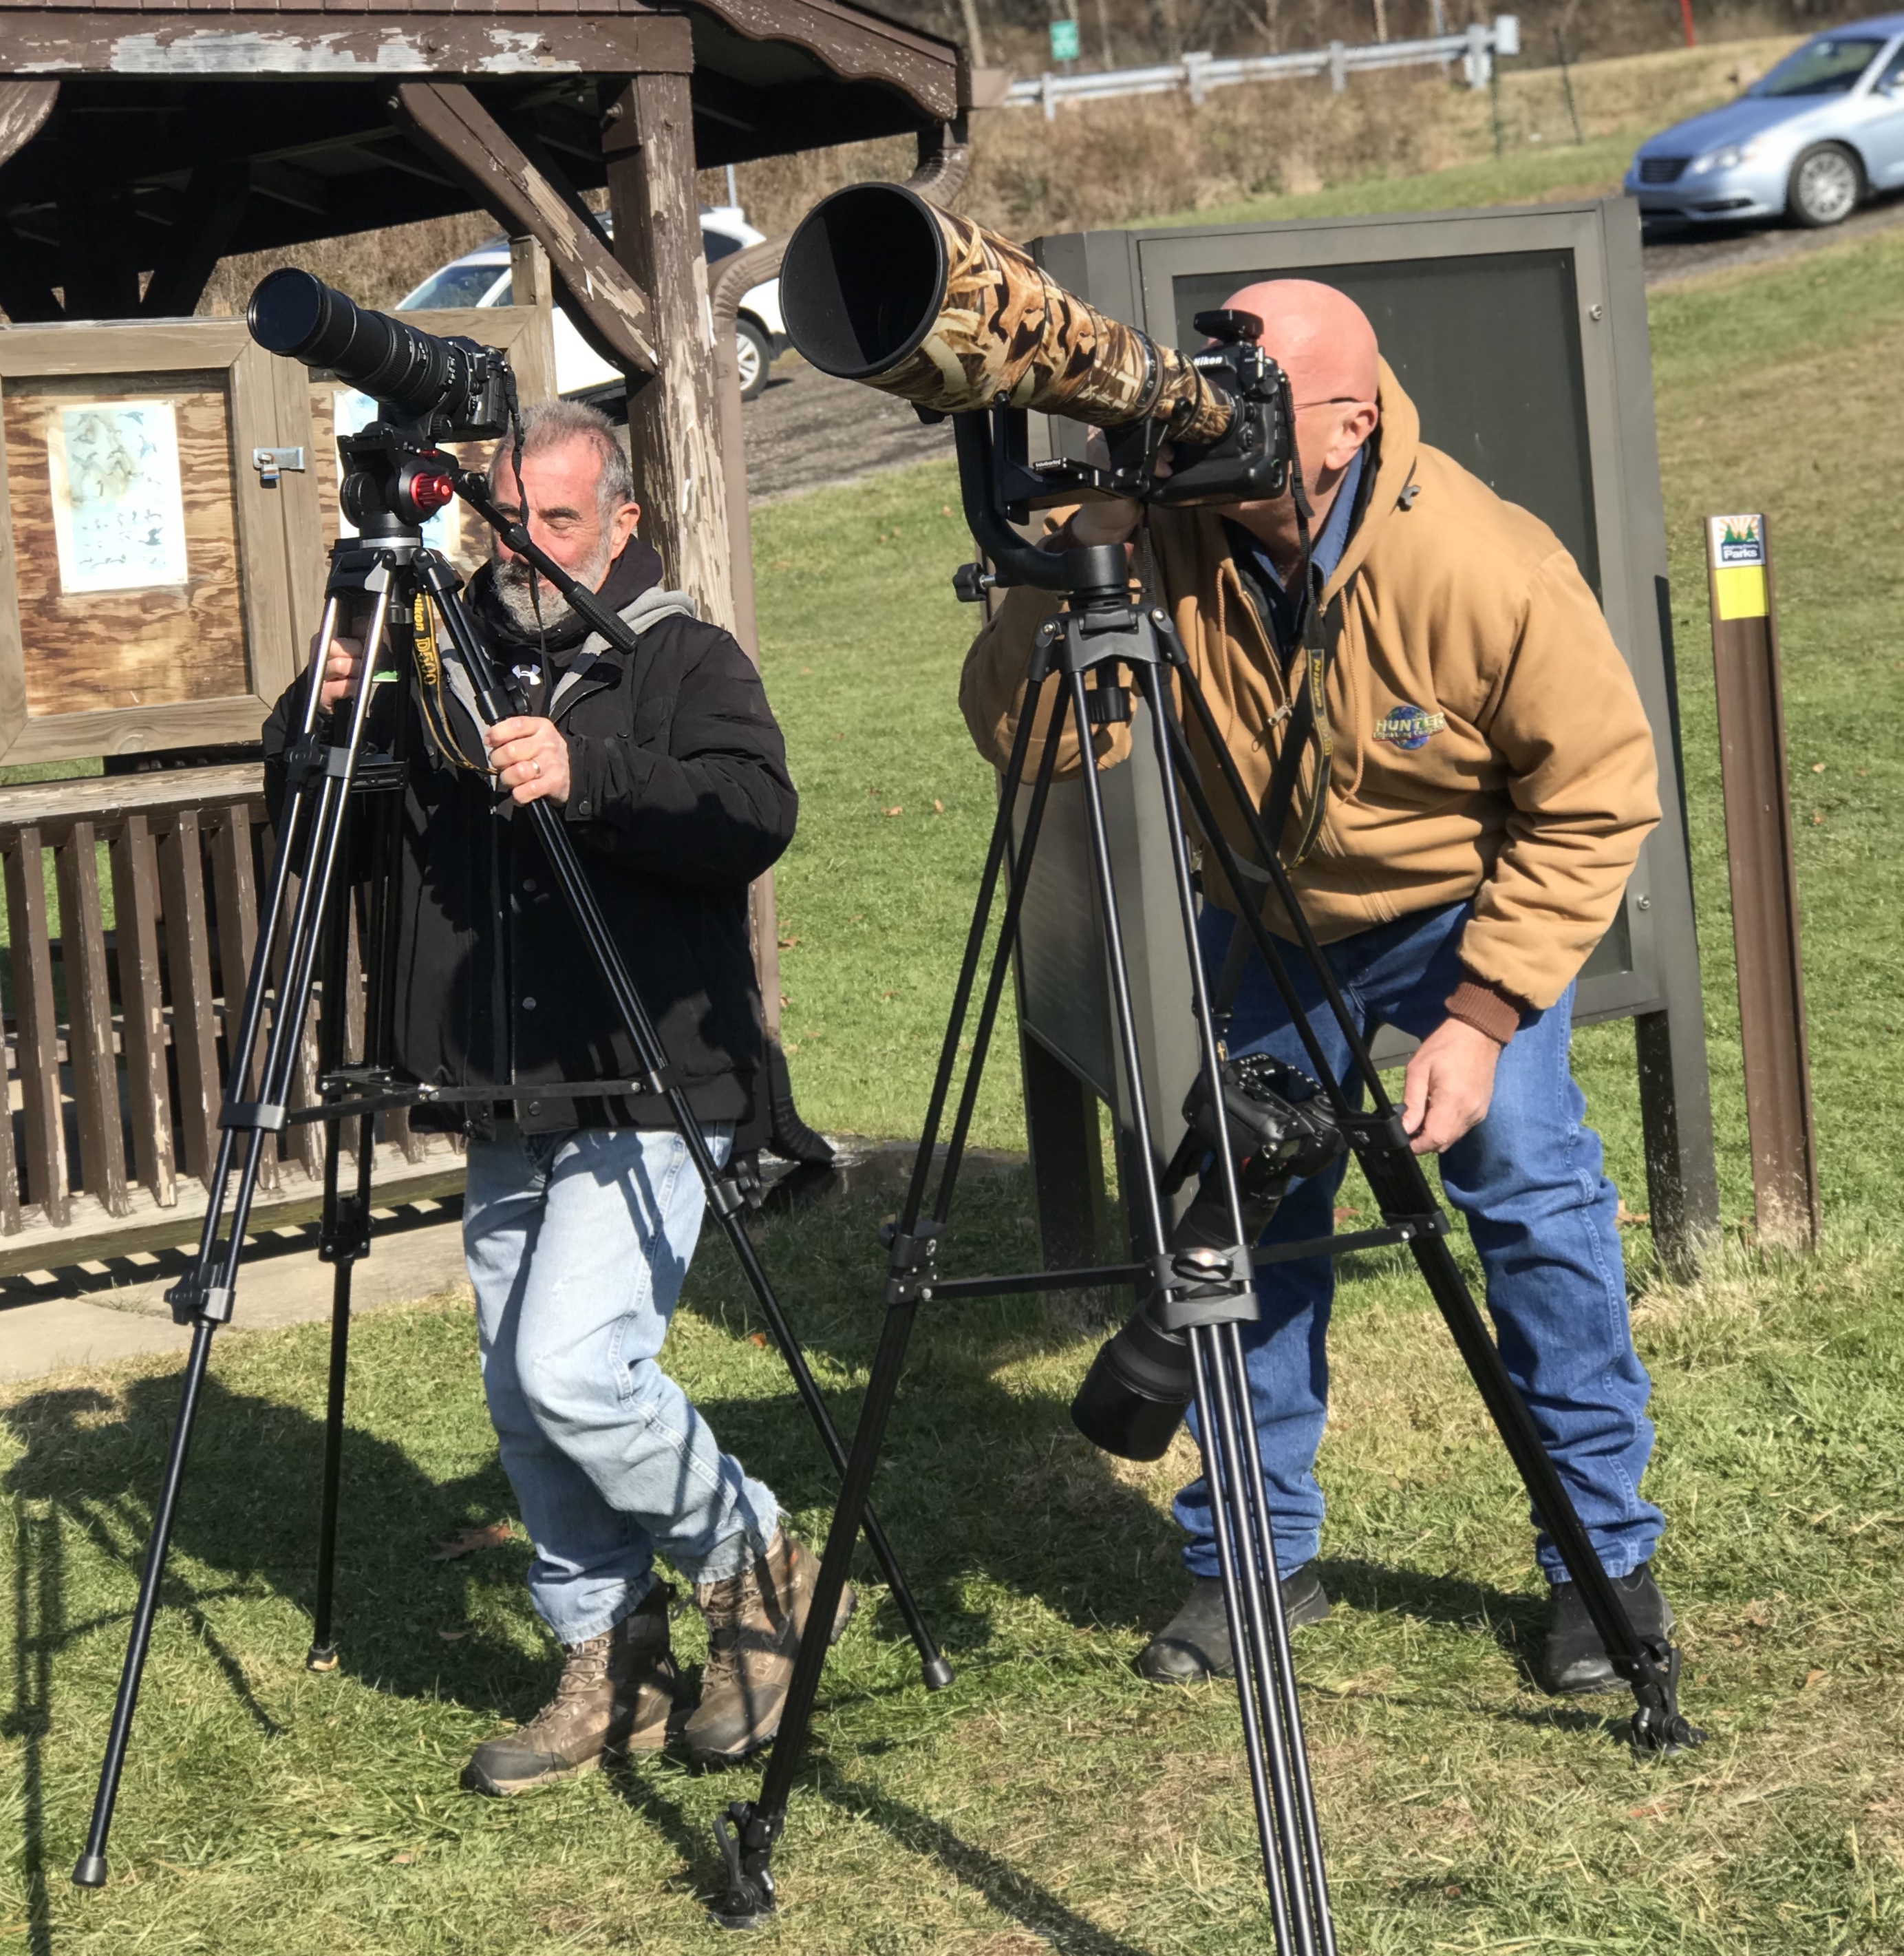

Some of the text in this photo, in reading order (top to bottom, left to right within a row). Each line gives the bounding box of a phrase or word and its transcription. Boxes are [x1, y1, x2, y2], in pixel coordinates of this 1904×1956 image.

[1194, 356, 1223, 366] Nikon
[1724, 549, 1758, 559] Parks
[414, 637, 436, 685] D500
[1313, 658, 1322, 708] Nikon
[1376, 712, 1444, 732] HUNTER
